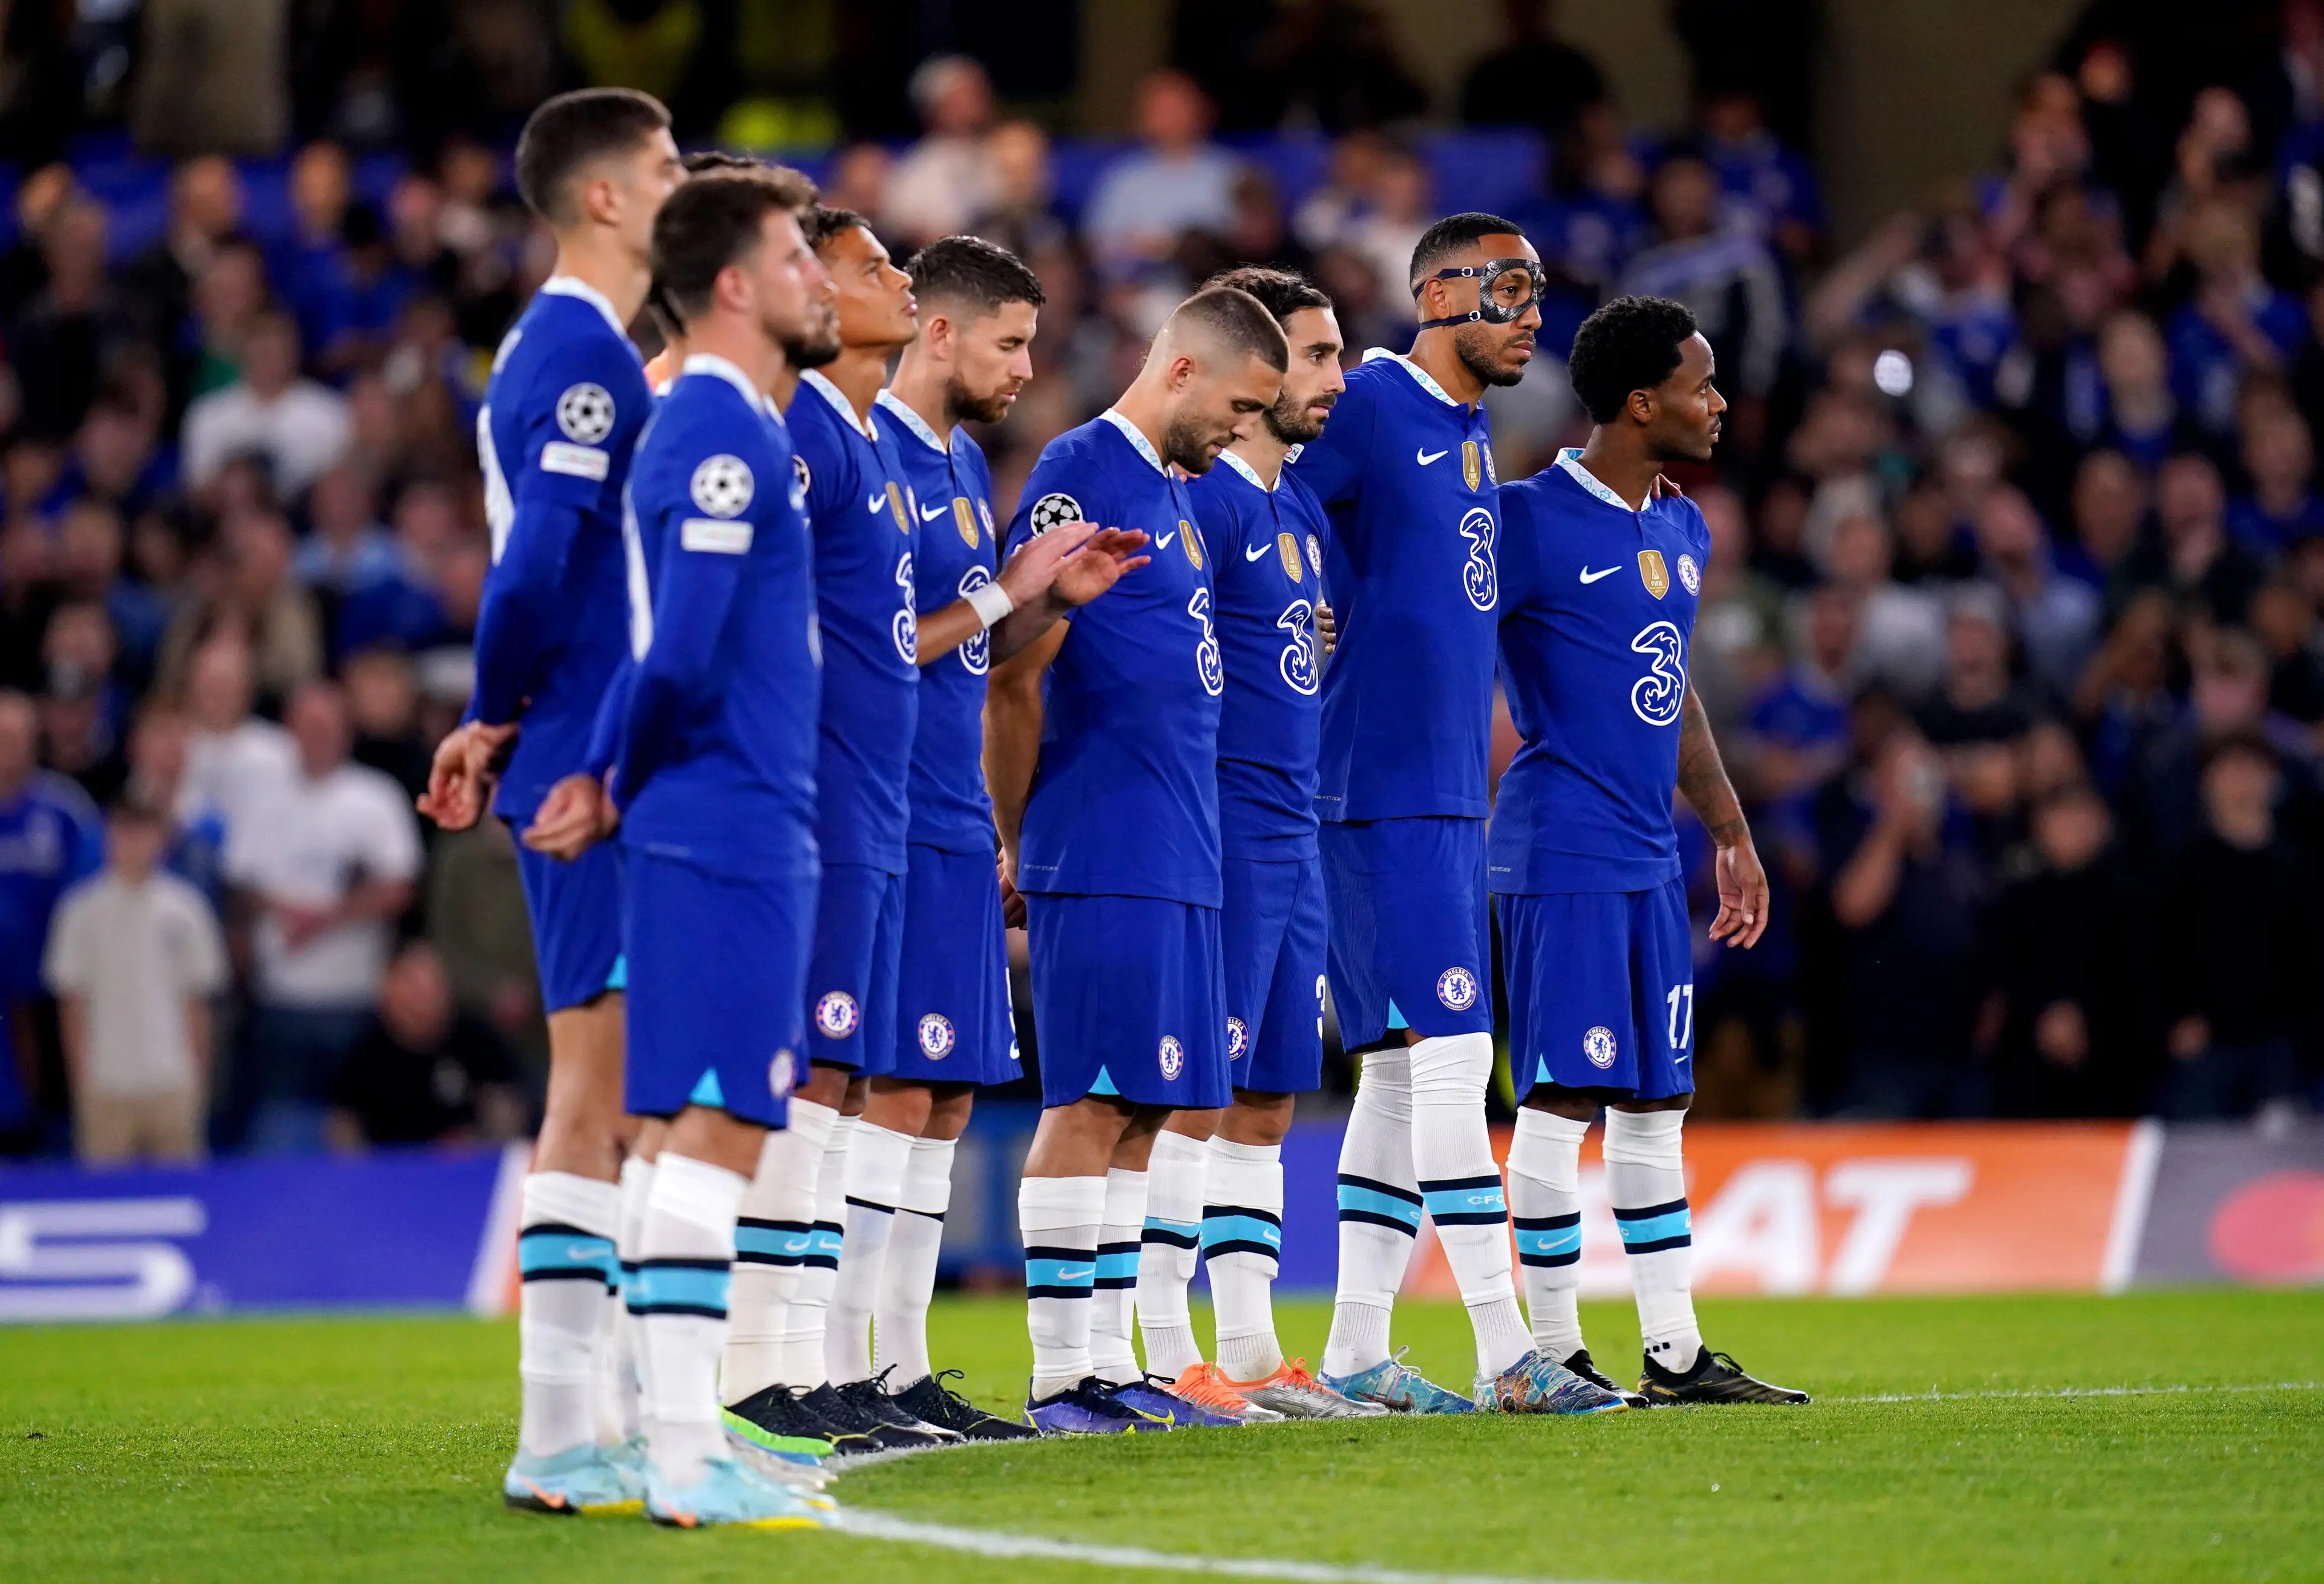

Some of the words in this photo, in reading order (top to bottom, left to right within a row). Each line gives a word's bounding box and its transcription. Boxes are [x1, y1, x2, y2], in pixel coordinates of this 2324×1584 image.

[1459, 507, 1497, 612] 3
[1276, 599, 1319, 695] 3
[1631, 621, 1686, 726] 3
[1443, 969, 1469, 978] CHELSEA
[1227, 1018, 1244, 1031] ELSEA
[1588, 1028, 1611, 1038] CHELSEA
[1667, 984, 1693, 1049] 17
[1467, 1195, 1504, 1205] CFC
